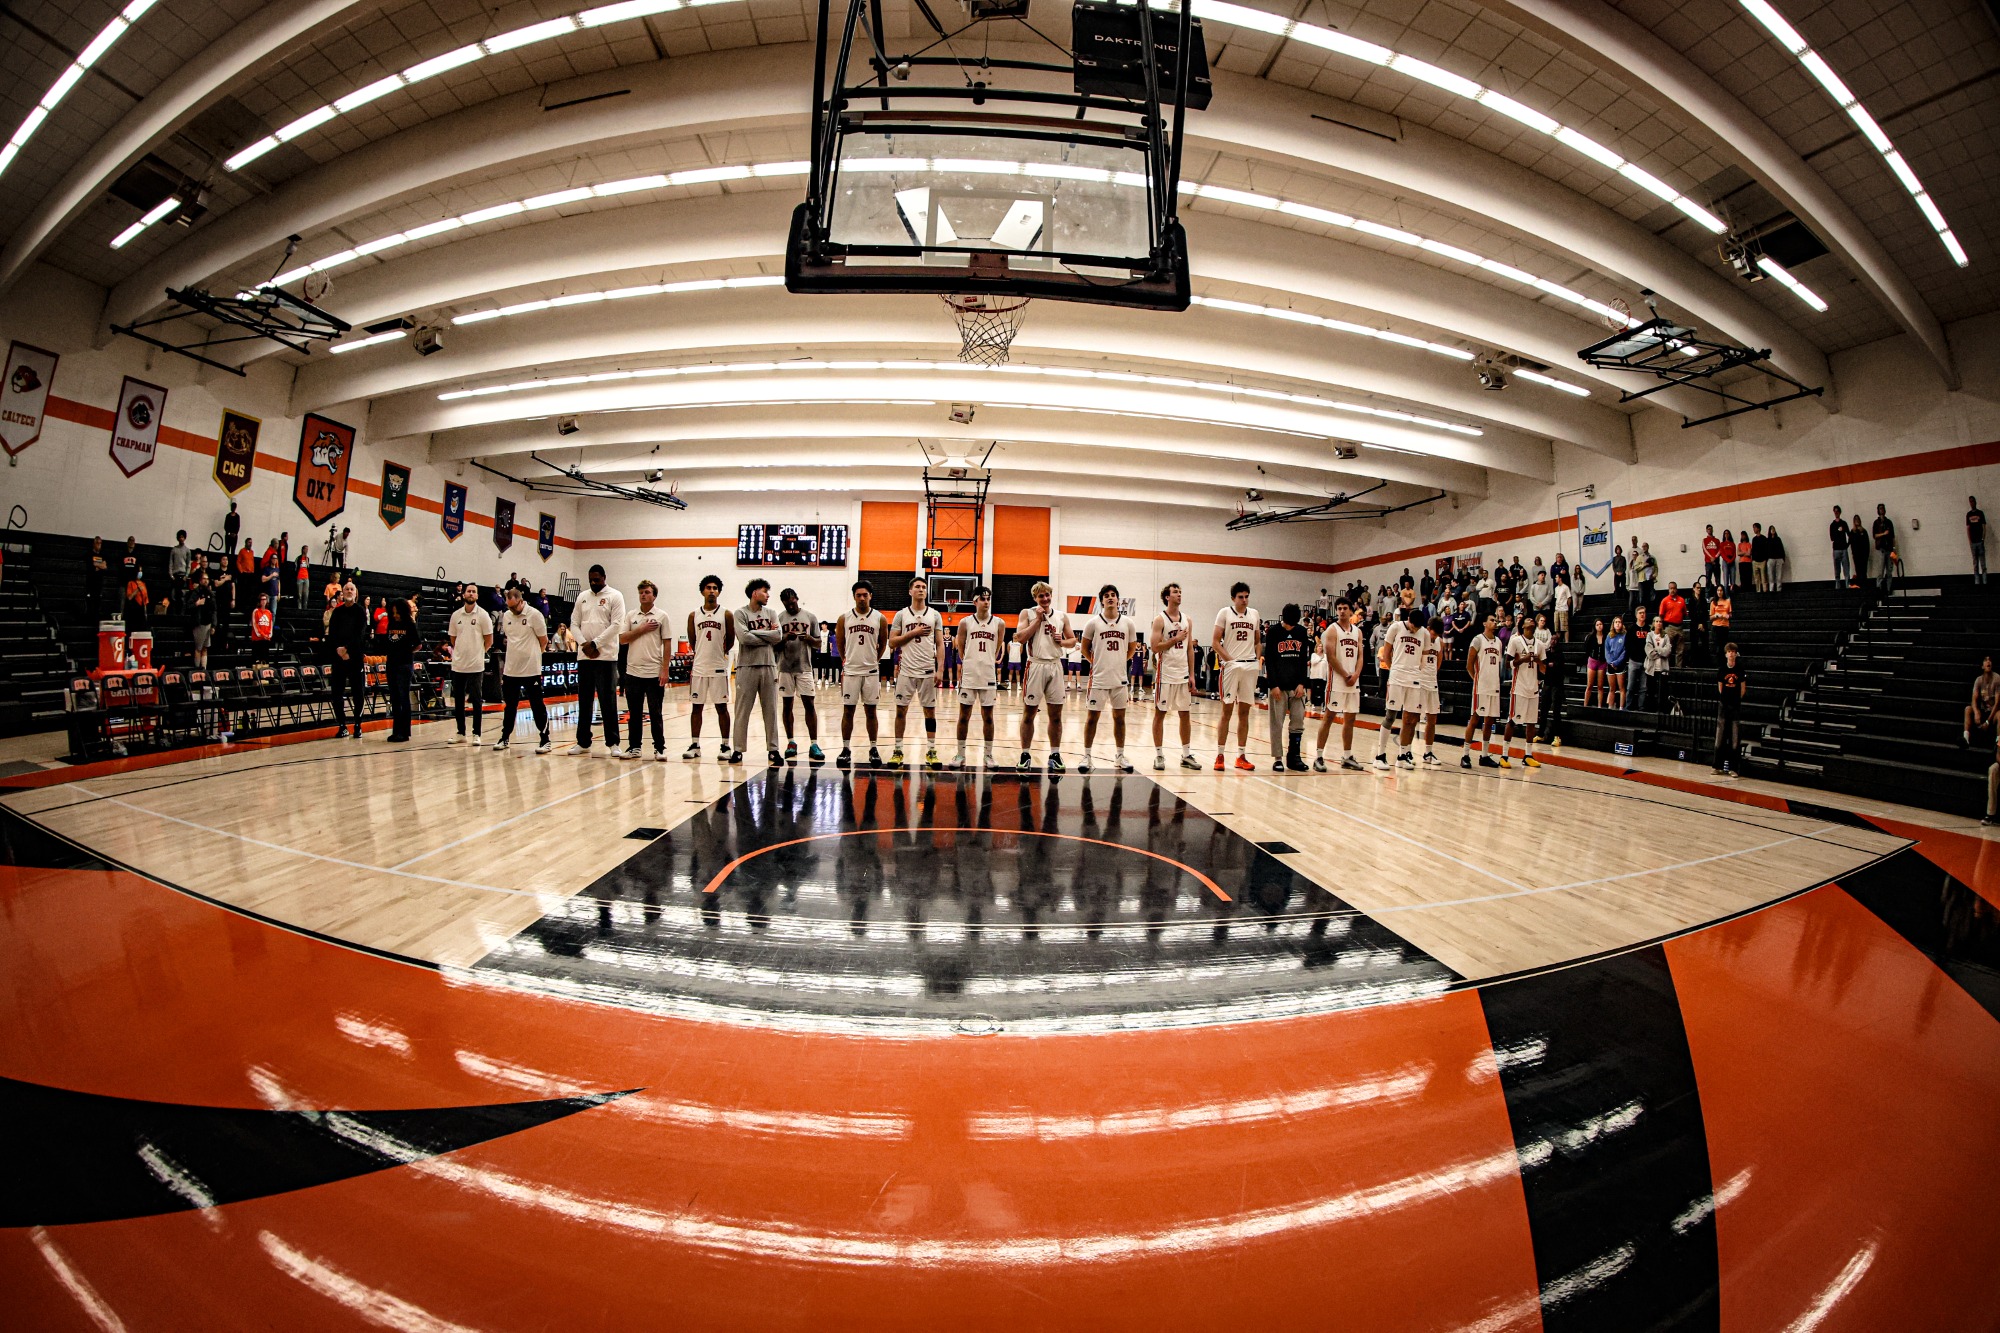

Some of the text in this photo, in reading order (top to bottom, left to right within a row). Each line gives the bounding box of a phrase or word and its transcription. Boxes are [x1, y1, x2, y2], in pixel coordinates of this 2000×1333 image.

[2, 410, 36, 427] CALTECH
[116, 436, 152, 453] CHAPMAN
[222, 460, 245, 478] CMS
[306, 478, 336, 502] OXY
[780, 525, 805, 535] 20:00
[1584, 533, 1607, 545] SCIAC
[774, 541, 780, 550] 0
[811, 541, 817, 551] 0
[932, 557, 938, 567] 0
[748, 619, 772, 631] OXY
[782, 622, 809, 633] OXY
[849, 625, 874, 635] TIGERS
[1231, 622, 1254, 630] TIGERS
[706, 631, 712, 641] 4
[858, 635, 864, 645] 3
[970, 632, 994, 641] TIGERS
[1100, 631, 1125, 640] TIGERS
[1236, 631, 1247, 641] 22
[114, 639, 122, 651] G
[1107, 641, 1119, 651] 30
[1278, 640, 1302, 653] OXY
[1400, 636, 1421, 647] TIGERS
[140, 645, 148, 658] G
[979, 642, 986, 652] 11
[1405, 645, 1414, 655] 32
[1346, 648, 1353, 657] 23
[1490, 656, 1496, 665] 10
